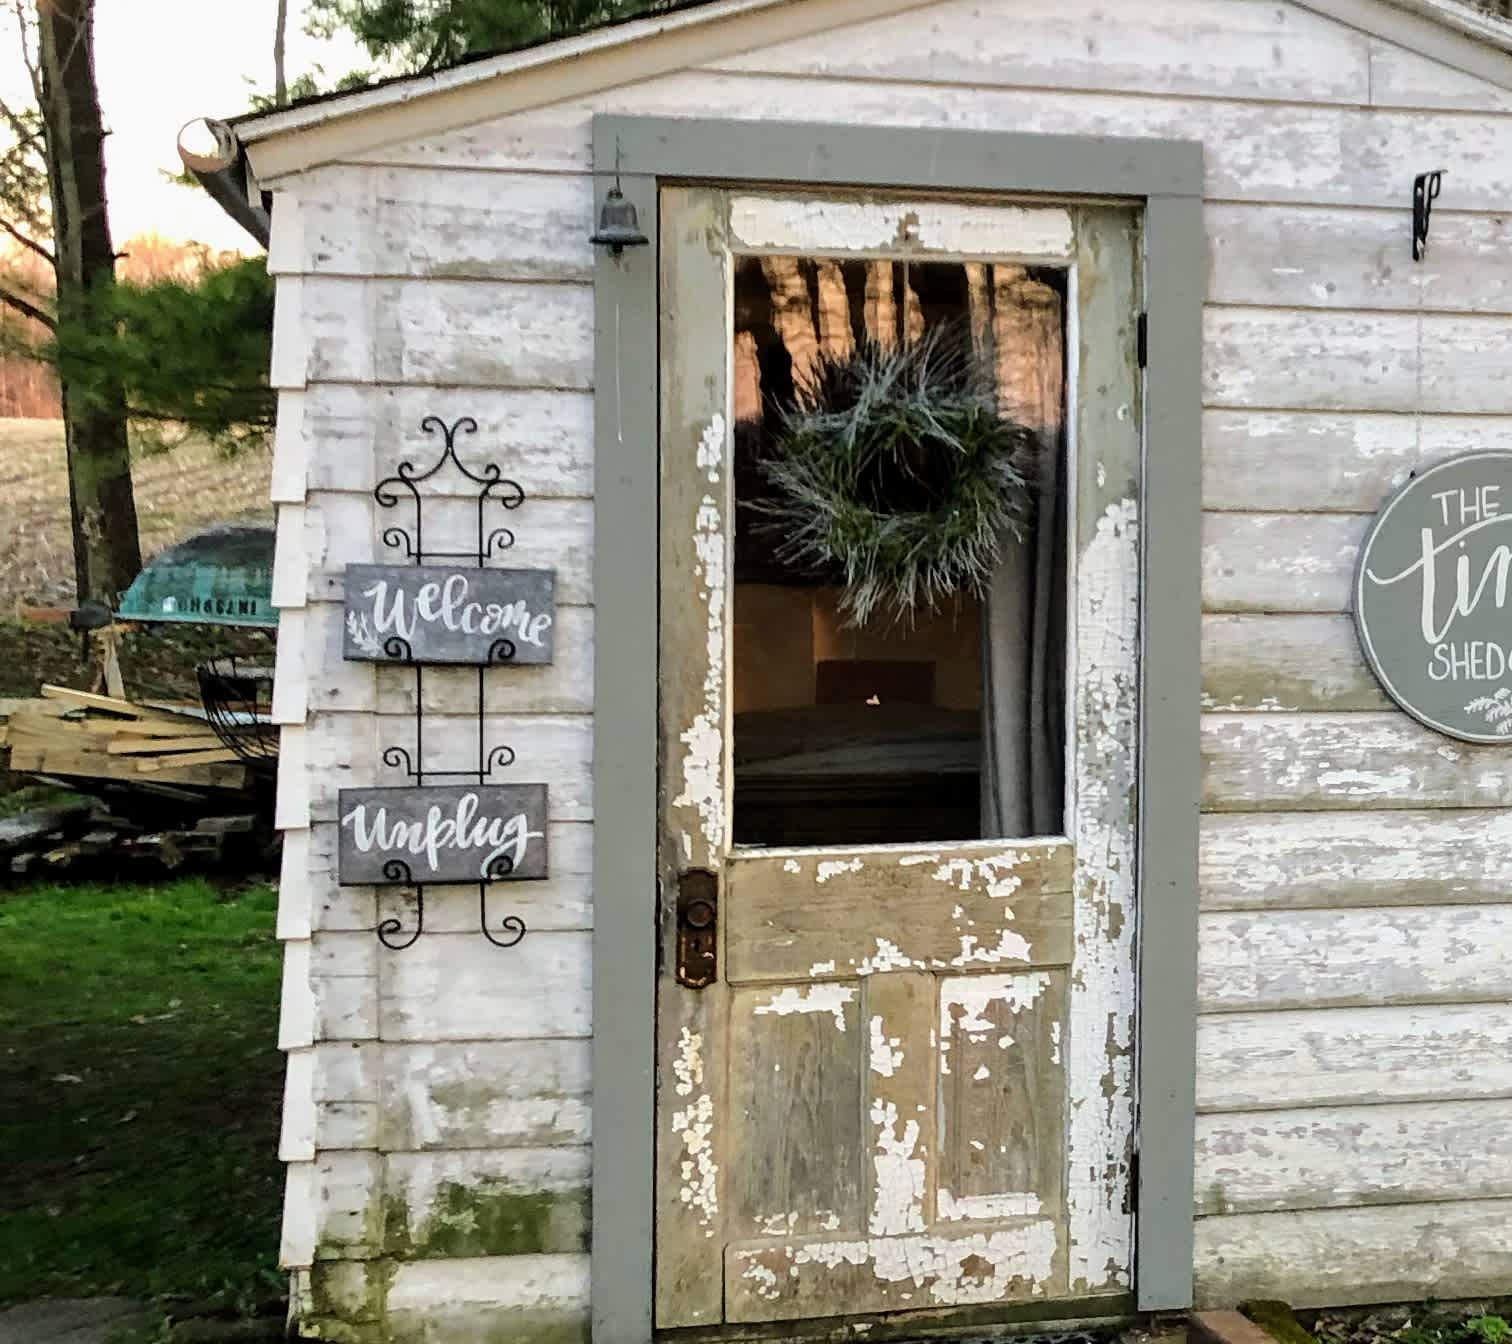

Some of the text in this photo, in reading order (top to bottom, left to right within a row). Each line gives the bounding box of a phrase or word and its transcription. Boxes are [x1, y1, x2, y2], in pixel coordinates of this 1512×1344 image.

[1431, 485, 1501, 526] THE
[363, 573, 553, 648] Welcome
[1427, 640, 1506, 681] SHED
[341, 792, 544, 880] Unplug
